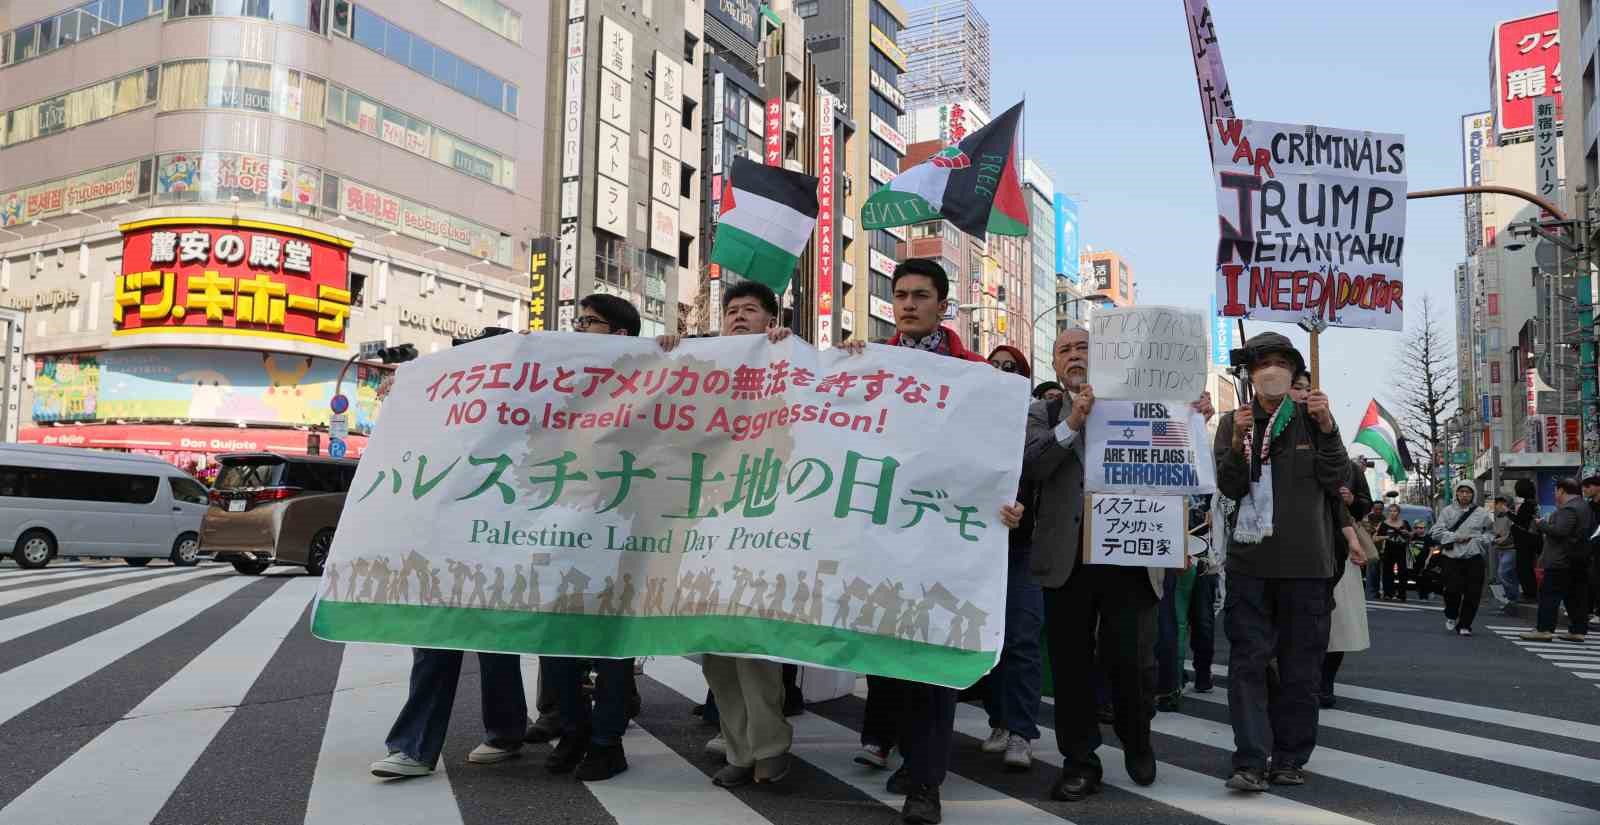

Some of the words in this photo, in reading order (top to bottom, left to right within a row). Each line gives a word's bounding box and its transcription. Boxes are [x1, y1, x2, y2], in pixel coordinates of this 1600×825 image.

[567, 63, 579, 172] KIBORI
[608, 31, 624, 225] 北海道レストラン
[769, 103, 779, 161] カラオケ
[822, 136, 831, 207] KARAOKE
[1216, 118, 1275, 179] WAR
[1271, 132, 1405, 175] CRIMINALS
[1219, 171, 1395, 238] TRUMP
[151, 231, 313, 273] 驚安の殿堂
[822, 226, 831, 276] PARTY
[1217, 215, 1404, 267] NETANYAHU
[1221, 264, 1246, 317] I
[1251, 266, 1325, 311] NEED
[399, 308, 427, 330] Don
[426, 359, 951, 409] イスラエルとアメリカの無法を許すな！
[180, 438, 206, 448] Don
[210, 438, 257, 450] Quijote
[445, 398, 487, 427] NO
[497, 401, 530, 426] to
[706, 401, 888, 441] Aggression!
[1103, 463, 1200, 487] TERRORISM
[1104, 448, 1126, 463] ARE
[1128, 448, 1148, 463] THE
[1150, 449, 1185, 464] FLAGS
[358, 447, 987, 542] パレスチナ土地の日デモ
[1094, 498, 1166, 515] イスラエル
[468, 519, 593, 548] Palestine
[604, 525, 673, 554] Land
[681, 530, 720, 560] Day
[728, 526, 813, 552] Protest
[1102, 538, 1172, 557] テロ国家
[1106, 518, 1164, 534] アメリカこそ
